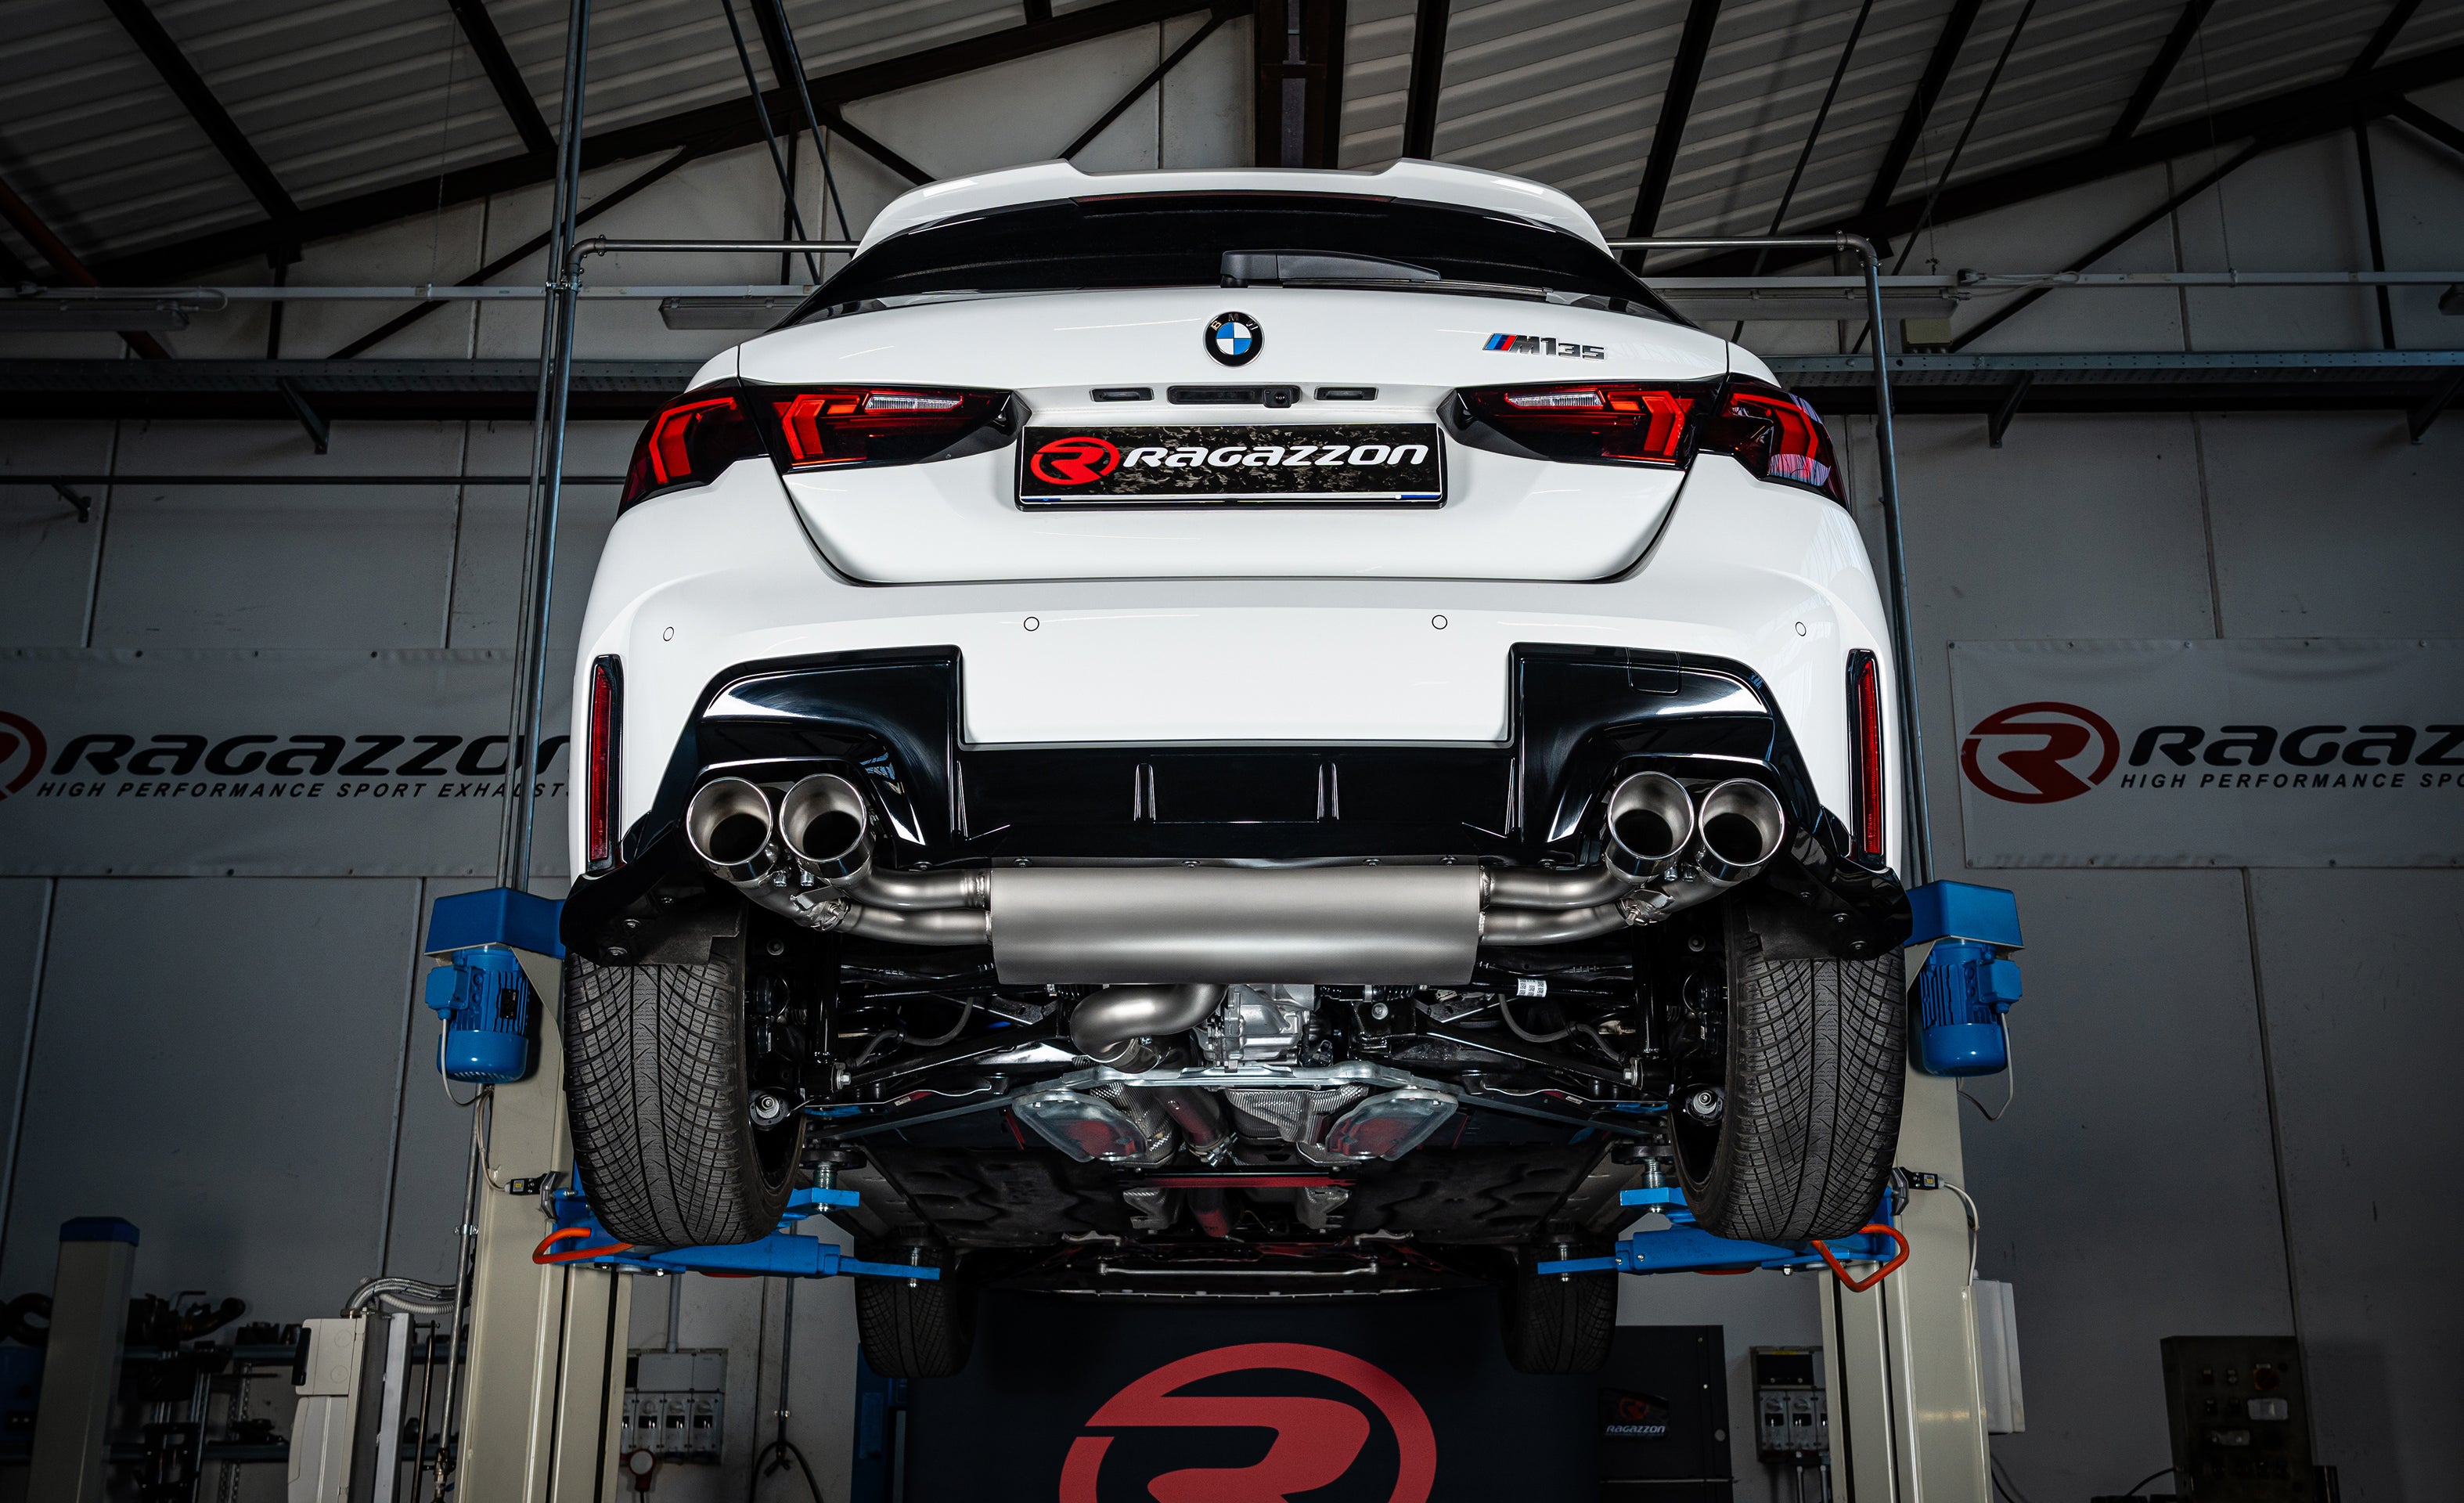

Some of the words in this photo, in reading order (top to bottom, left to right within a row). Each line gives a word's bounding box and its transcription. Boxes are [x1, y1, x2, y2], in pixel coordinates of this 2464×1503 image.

[1209, 312, 1259, 331] BMW
[1509, 334, 1605, 361] M135
[2120, 773, 2186, 788] HIGH
[2200, 773, 2405, 788] PERFORMANCE
[37, 782, 106, 797] HIGH
[116, 783, 325, 798] PERFORMANCE
[337, 784, 427, 798] SPORT
[438, 784, 569, 797] EXHAST
